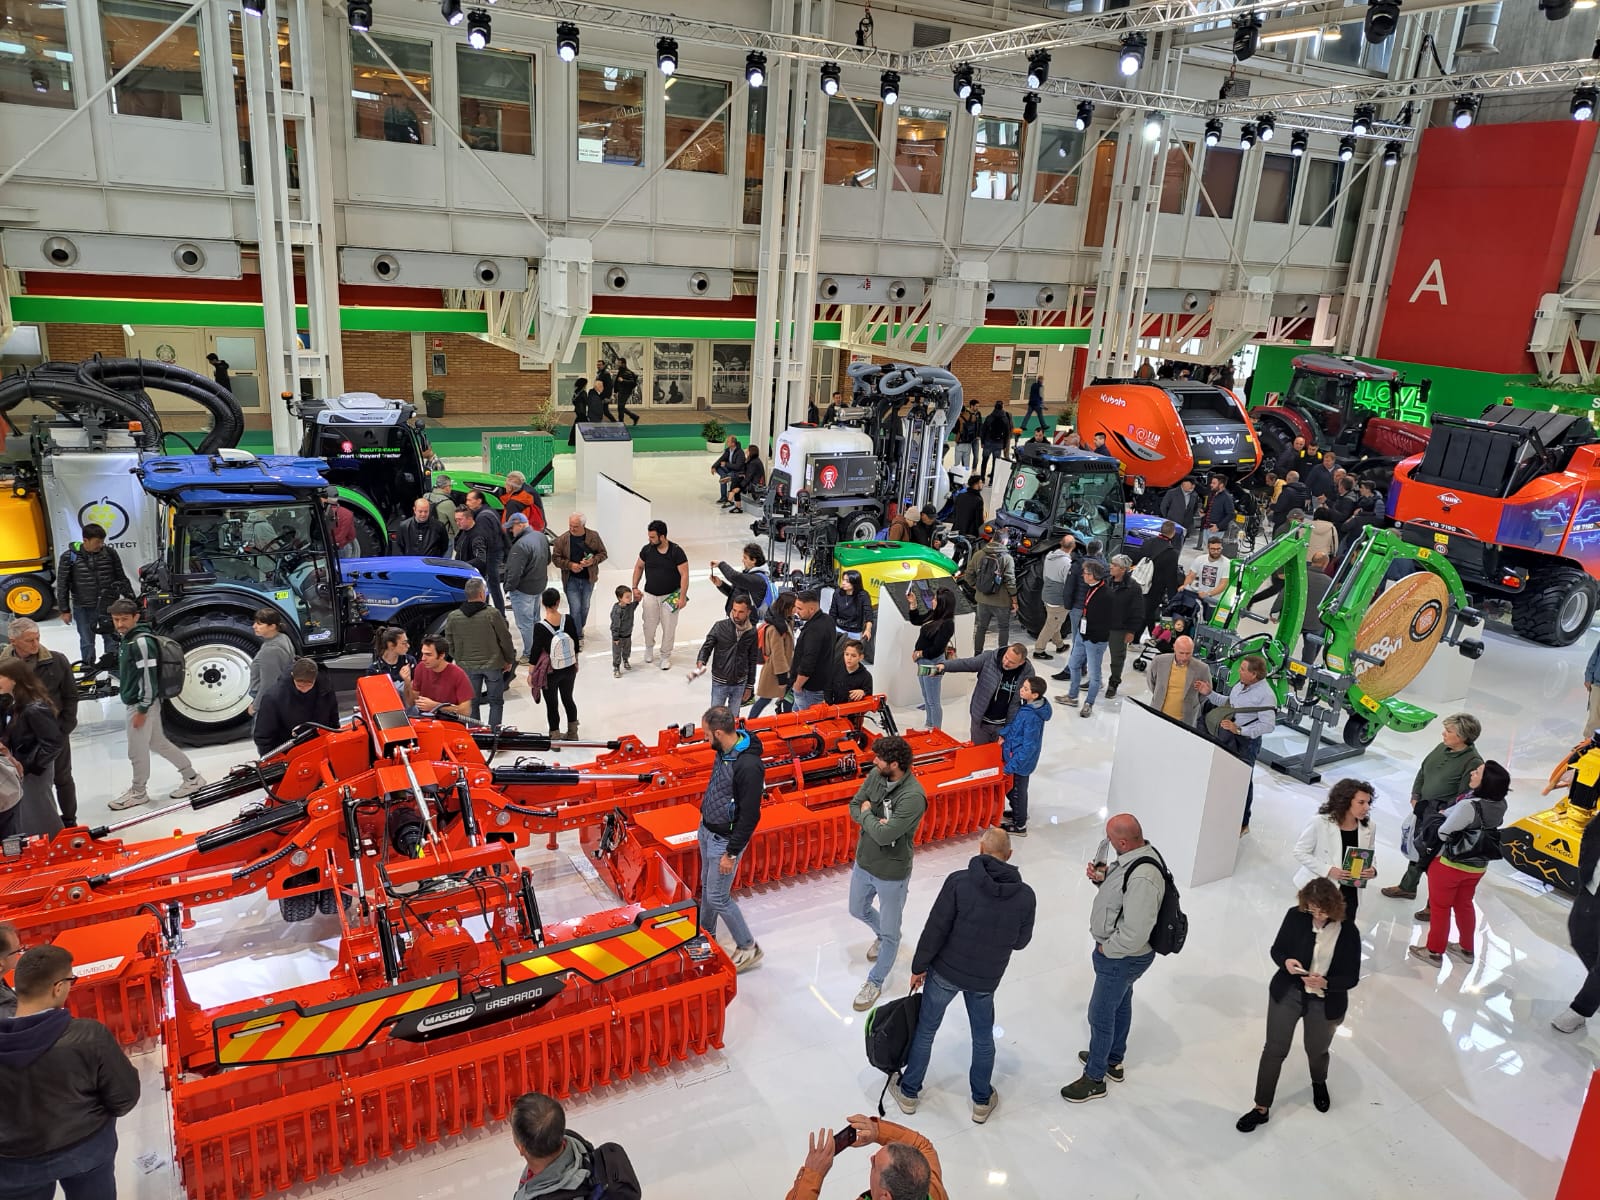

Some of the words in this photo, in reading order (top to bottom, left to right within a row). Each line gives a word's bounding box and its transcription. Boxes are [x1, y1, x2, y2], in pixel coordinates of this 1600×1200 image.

[1408, 258, 1448, 305] A
[1100, 393, 1126, 407] Kubota
[1206, 435, 1235, 445] Kubota
[1440, 494, 1458, 503] KUHN
[1545, 844, 1573, 858] ALPEGO
[424, 1006, 474, 1026] MASCHIO
[485, 987, 543, 1011] GASPARDO
